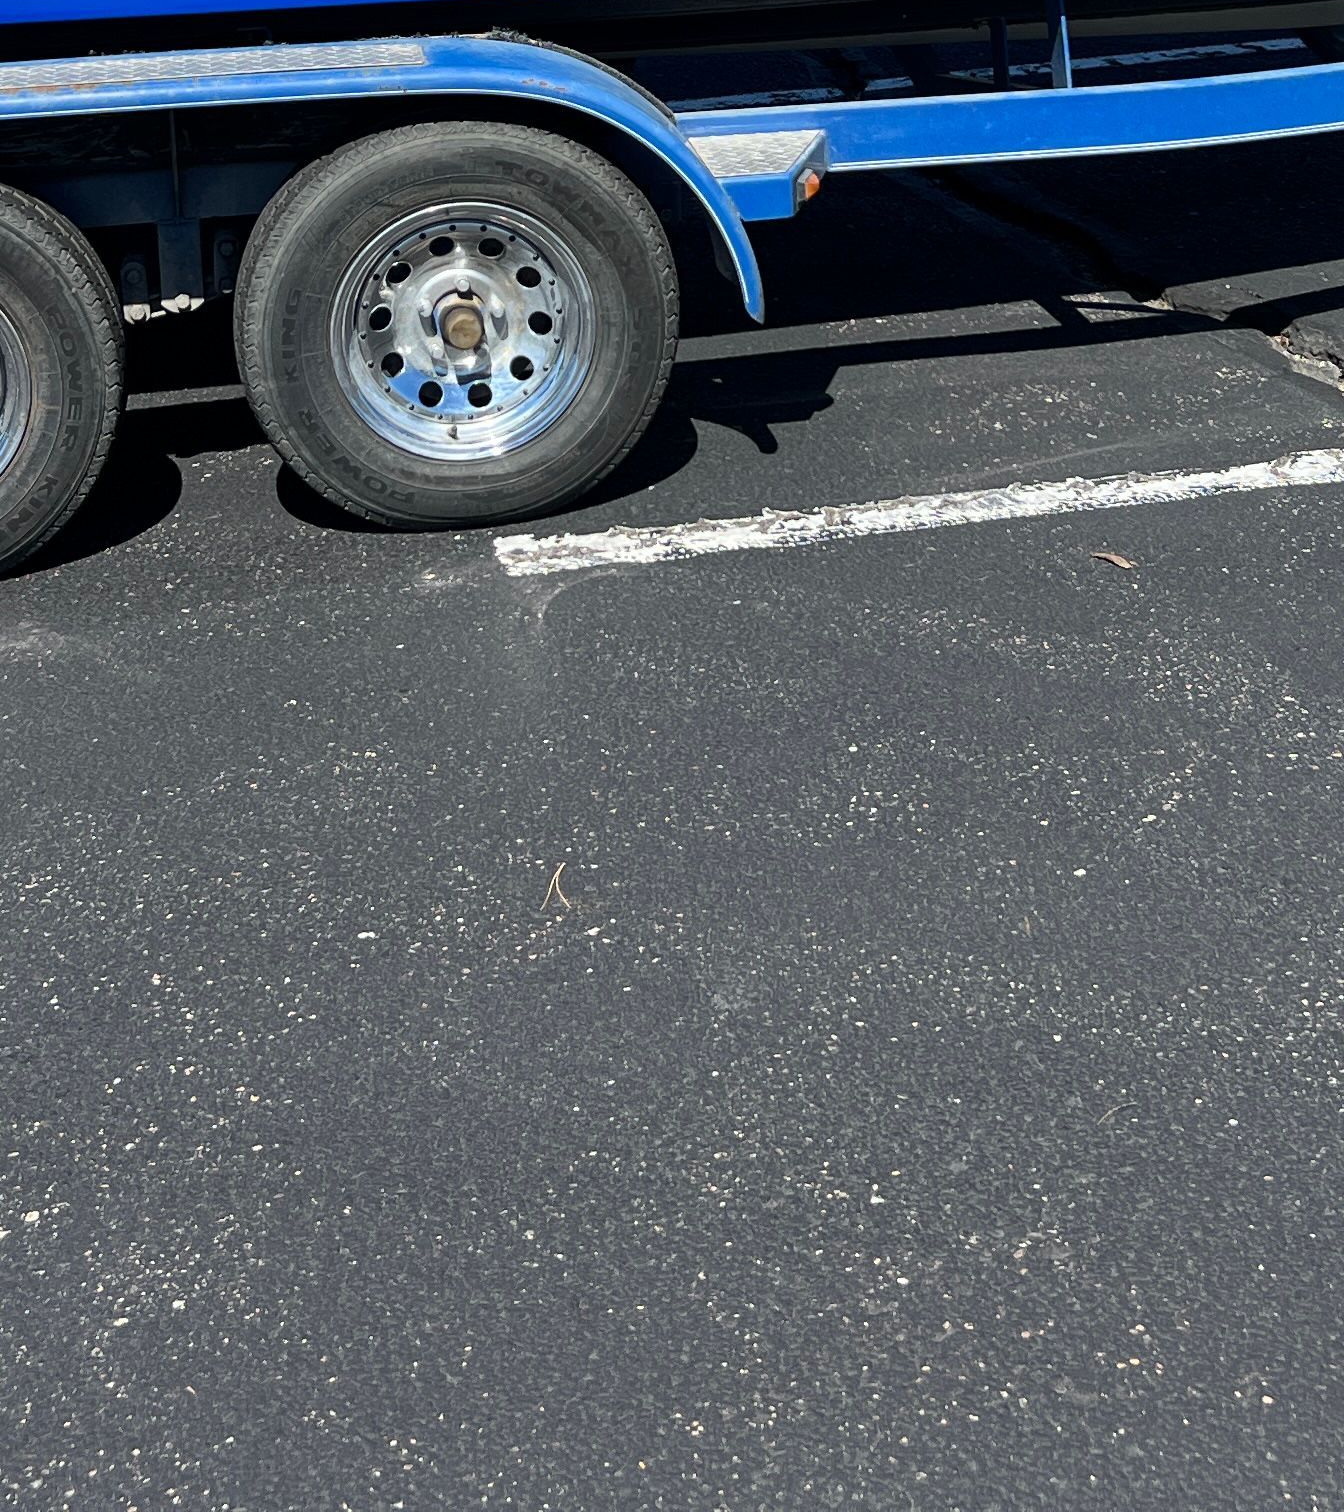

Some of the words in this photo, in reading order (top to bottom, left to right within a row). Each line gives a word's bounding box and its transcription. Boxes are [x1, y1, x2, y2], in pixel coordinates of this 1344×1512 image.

[45, 301, 89, 452] POWER
[282, 287, 304, 382] KING
[298, 408, 417, 506] POWER
